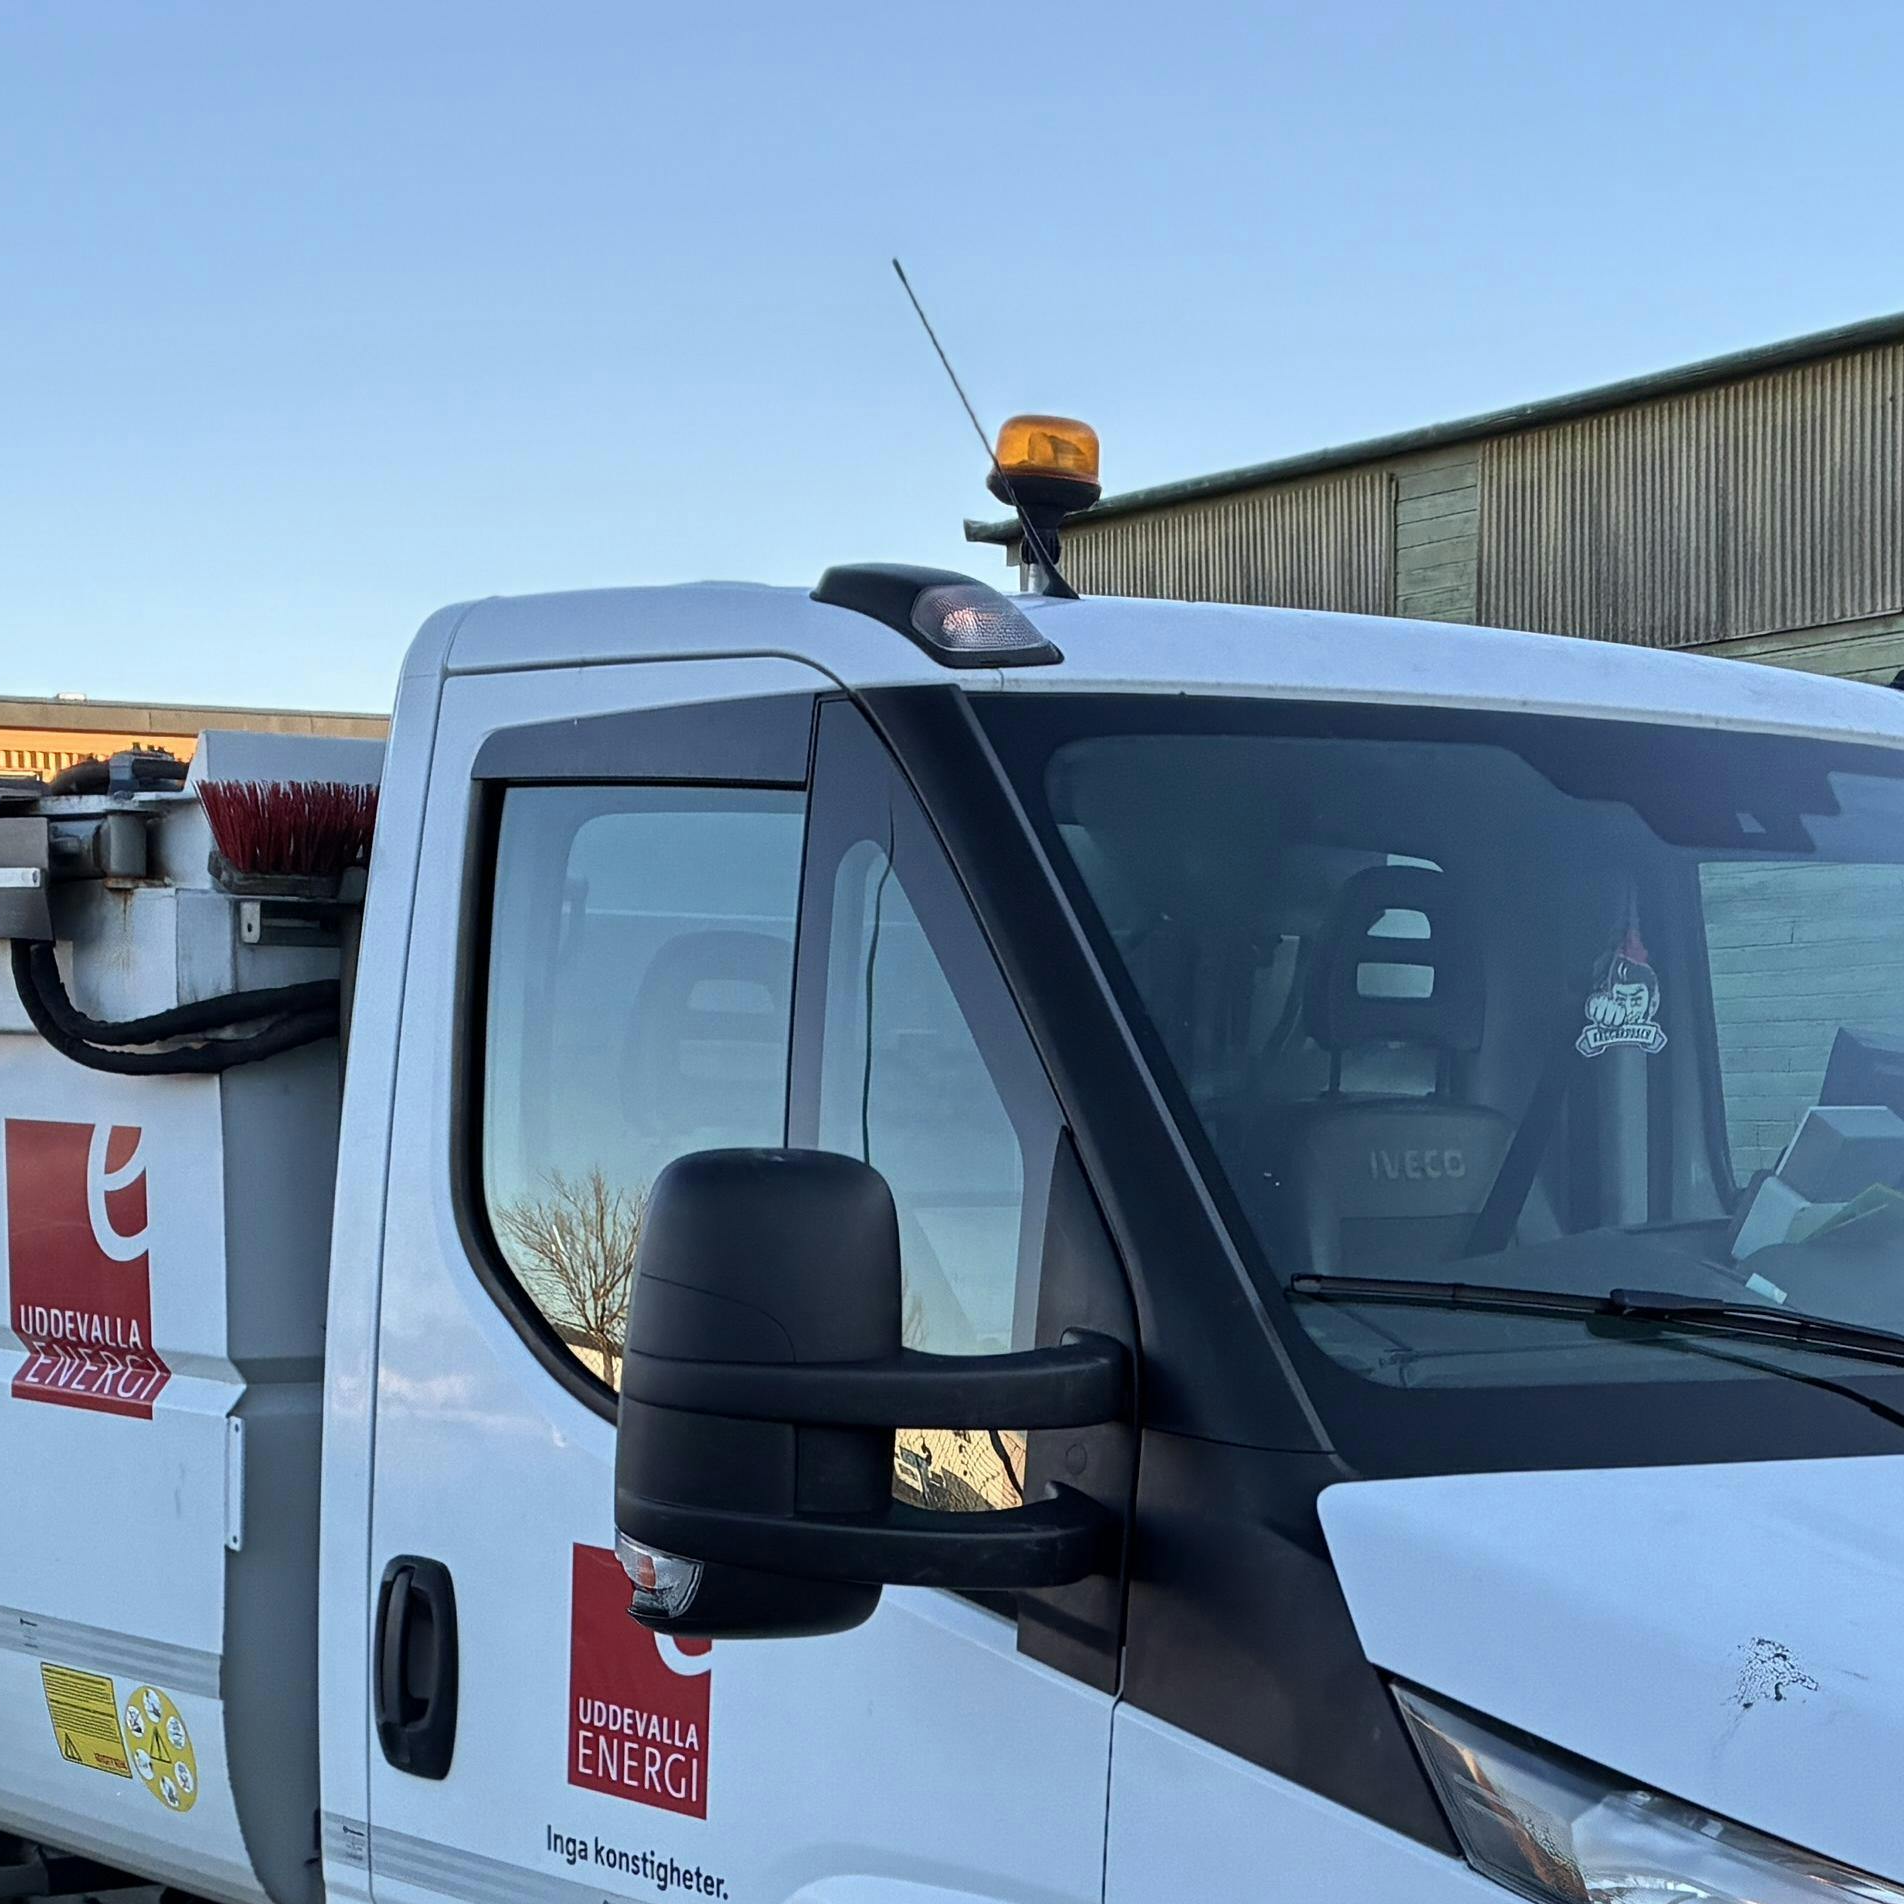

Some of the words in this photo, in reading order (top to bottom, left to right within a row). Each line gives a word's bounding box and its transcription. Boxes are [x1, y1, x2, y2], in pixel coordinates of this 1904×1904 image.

[1369, 1148, 1467, 1180] IVECO
[19, 1304, 145, 1351] UDDEVALLA
[25, 1341, 162, 1400] ENERGI
[578, 1696, 700, 1751] UDDEVALLA
[577, 1730, 698, 1802] ENERGI
[546, 1824, 588, 1866] Inga
[594, 1836, 729, 1902] konstigheter.
